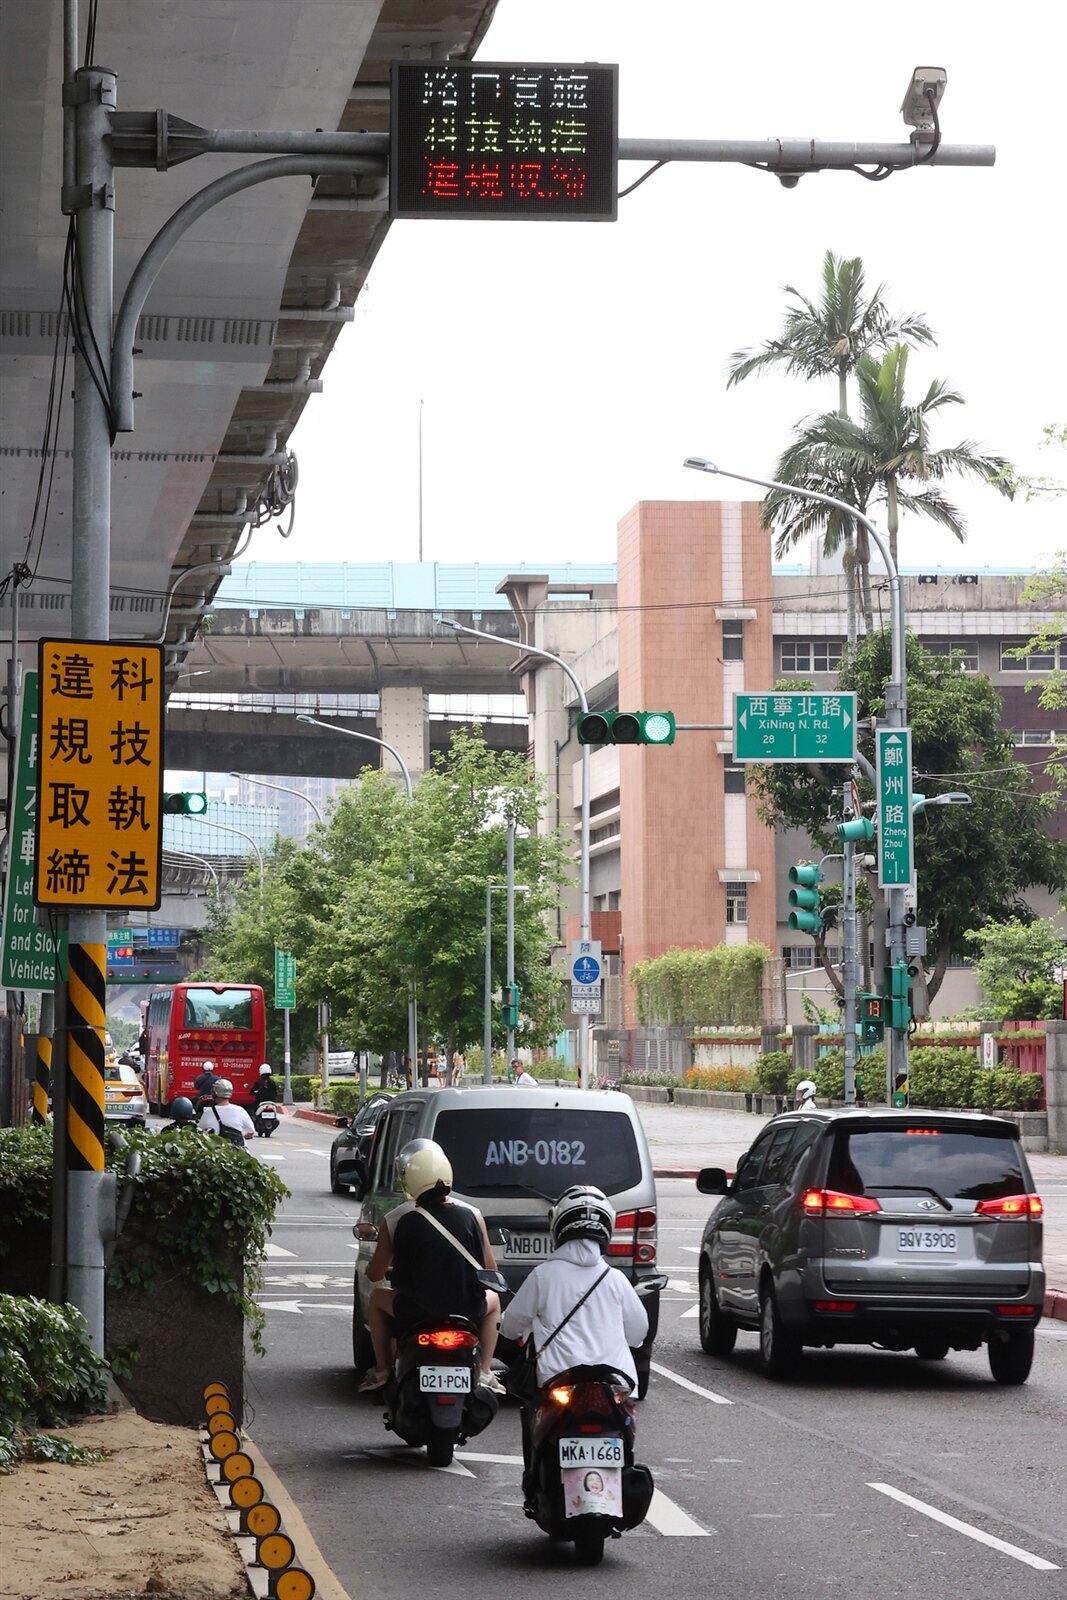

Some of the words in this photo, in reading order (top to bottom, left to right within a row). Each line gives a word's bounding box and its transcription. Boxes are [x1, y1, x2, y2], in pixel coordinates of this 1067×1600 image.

[748, 696, 842, 717] 西寧北路
[758, 719, 795, 732] XiNing
[798, 719, 810, 729] N.
[813, 719, 831, 729] Rd.
[762, 734, 775, 744] 28
[815, 734, 828, 744] 32
[45, 652, 95, 896] 違規取締
[106, 655, 154, 897] 科技執法
[884, 747, 904, 824] 鄭州路
[884, 827, 907, 838] Zheng
[884, 839, 903, 848] Zhou
[884, 851, 897, 860] Rd.
[15, 875, 34, 896] Lef
[13, 903, 29, 923] for
[10, 932, 31, 951] and
[9, 958, 56, 981] Vehicles
[869, 1000, 880, 1017] 13
[485, 1140, 587, 1166] ANB-0182
[505, 1237, 554, 1254] ANB-01
[421, 1374, 470, 1389] 021-PCN
[561, 1445, 622, 1461] MKA-1668
